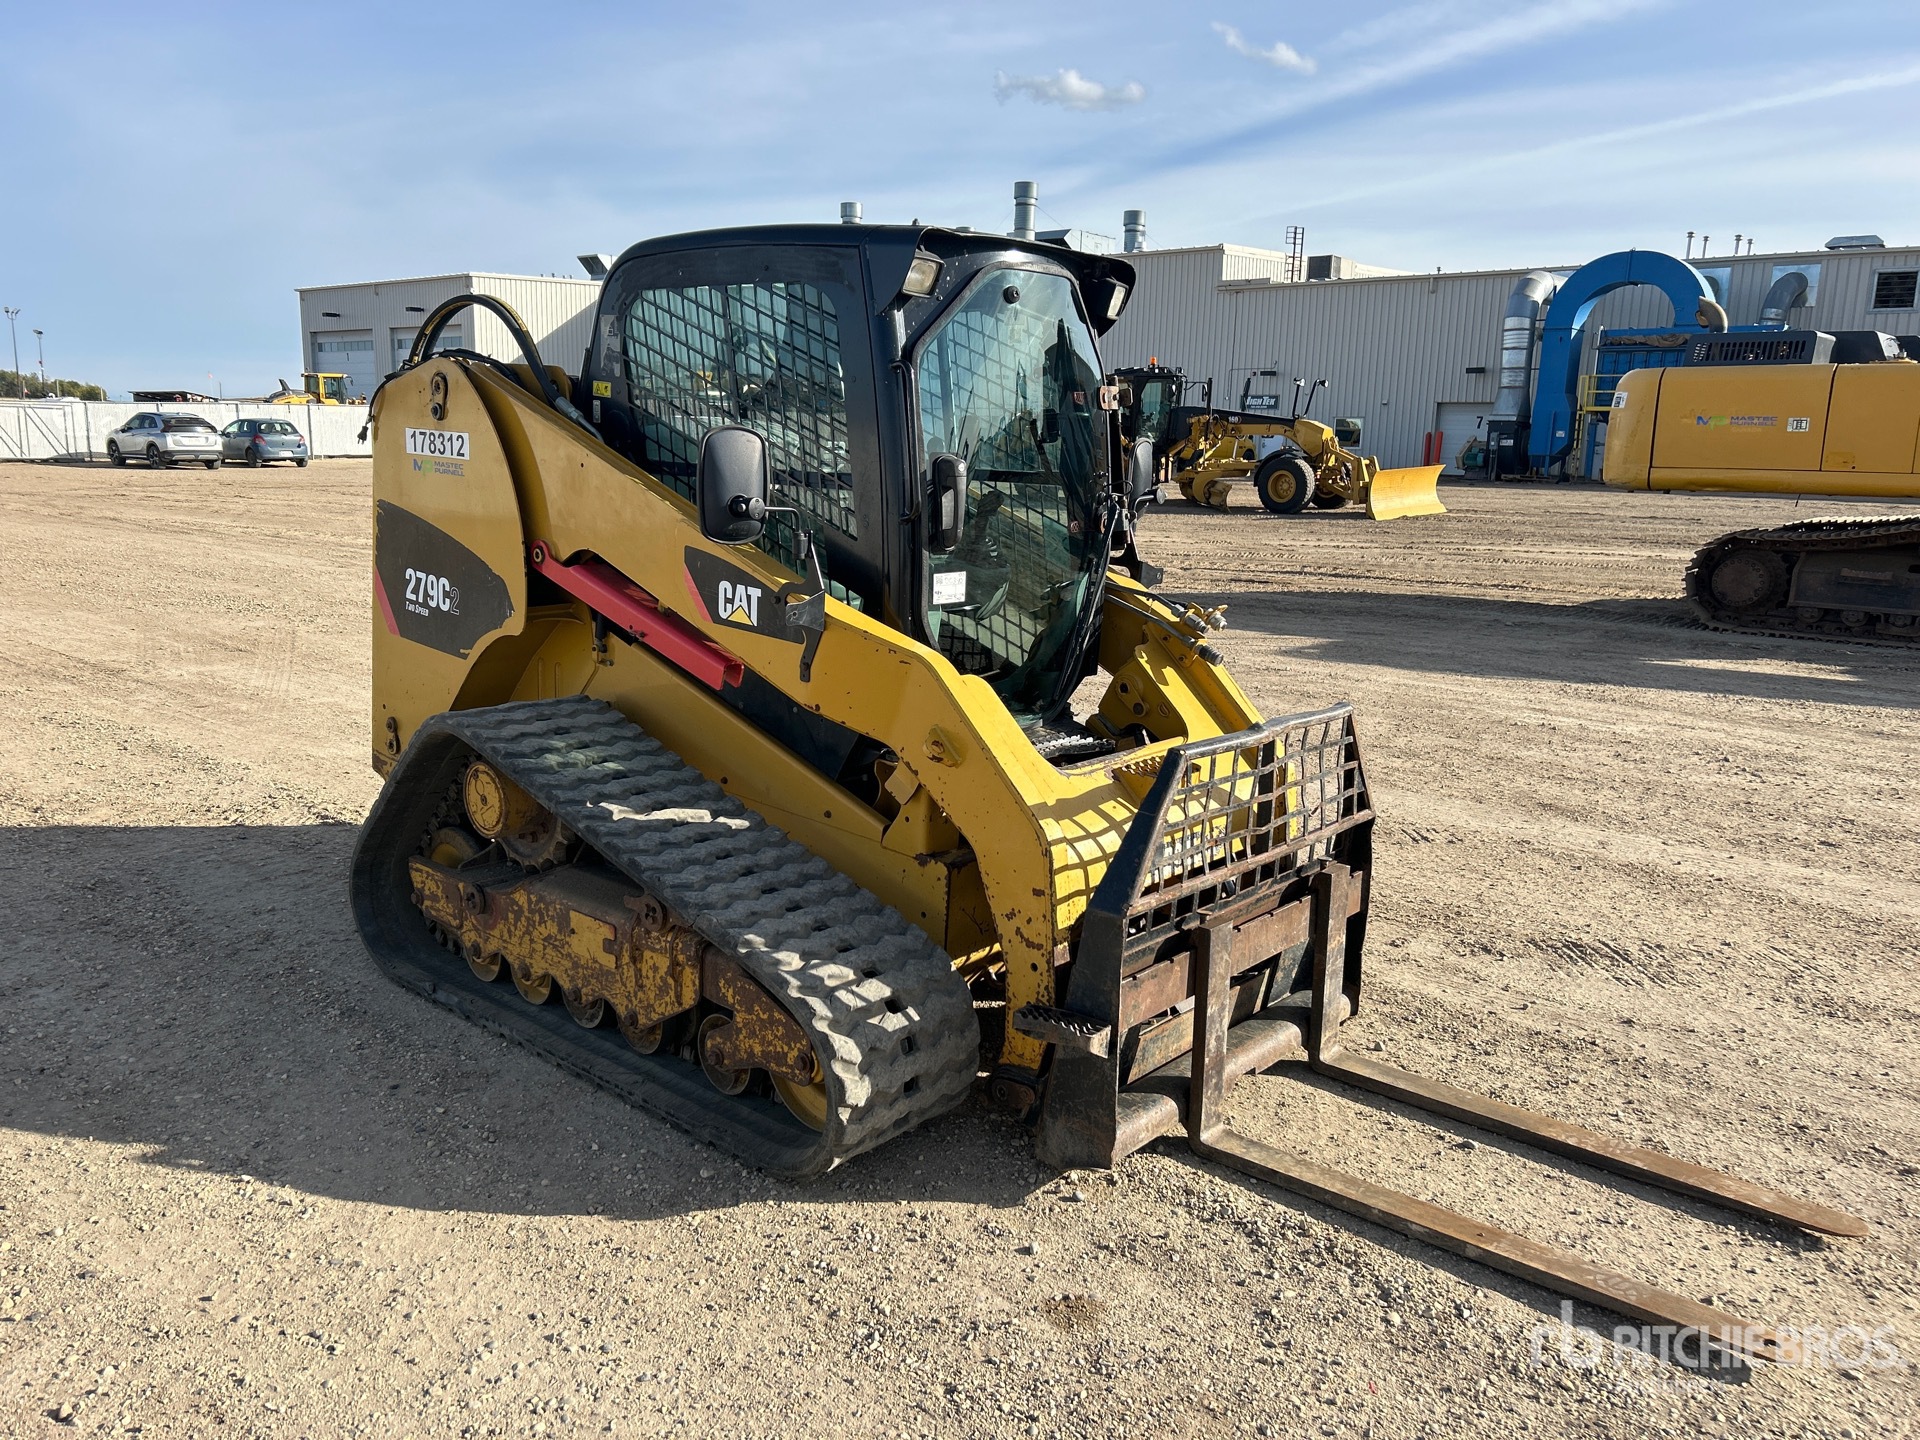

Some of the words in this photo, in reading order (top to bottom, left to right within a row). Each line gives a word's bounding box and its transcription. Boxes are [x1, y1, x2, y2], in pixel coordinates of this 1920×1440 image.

[1476, 415, 1484, 429] 7
[410, 430, 465, 457] 178312
[434, 460, 464, 470] MASTEC
[434, 467, 465, 477] PURNELL
[718, 580, 762, 627] CAT
